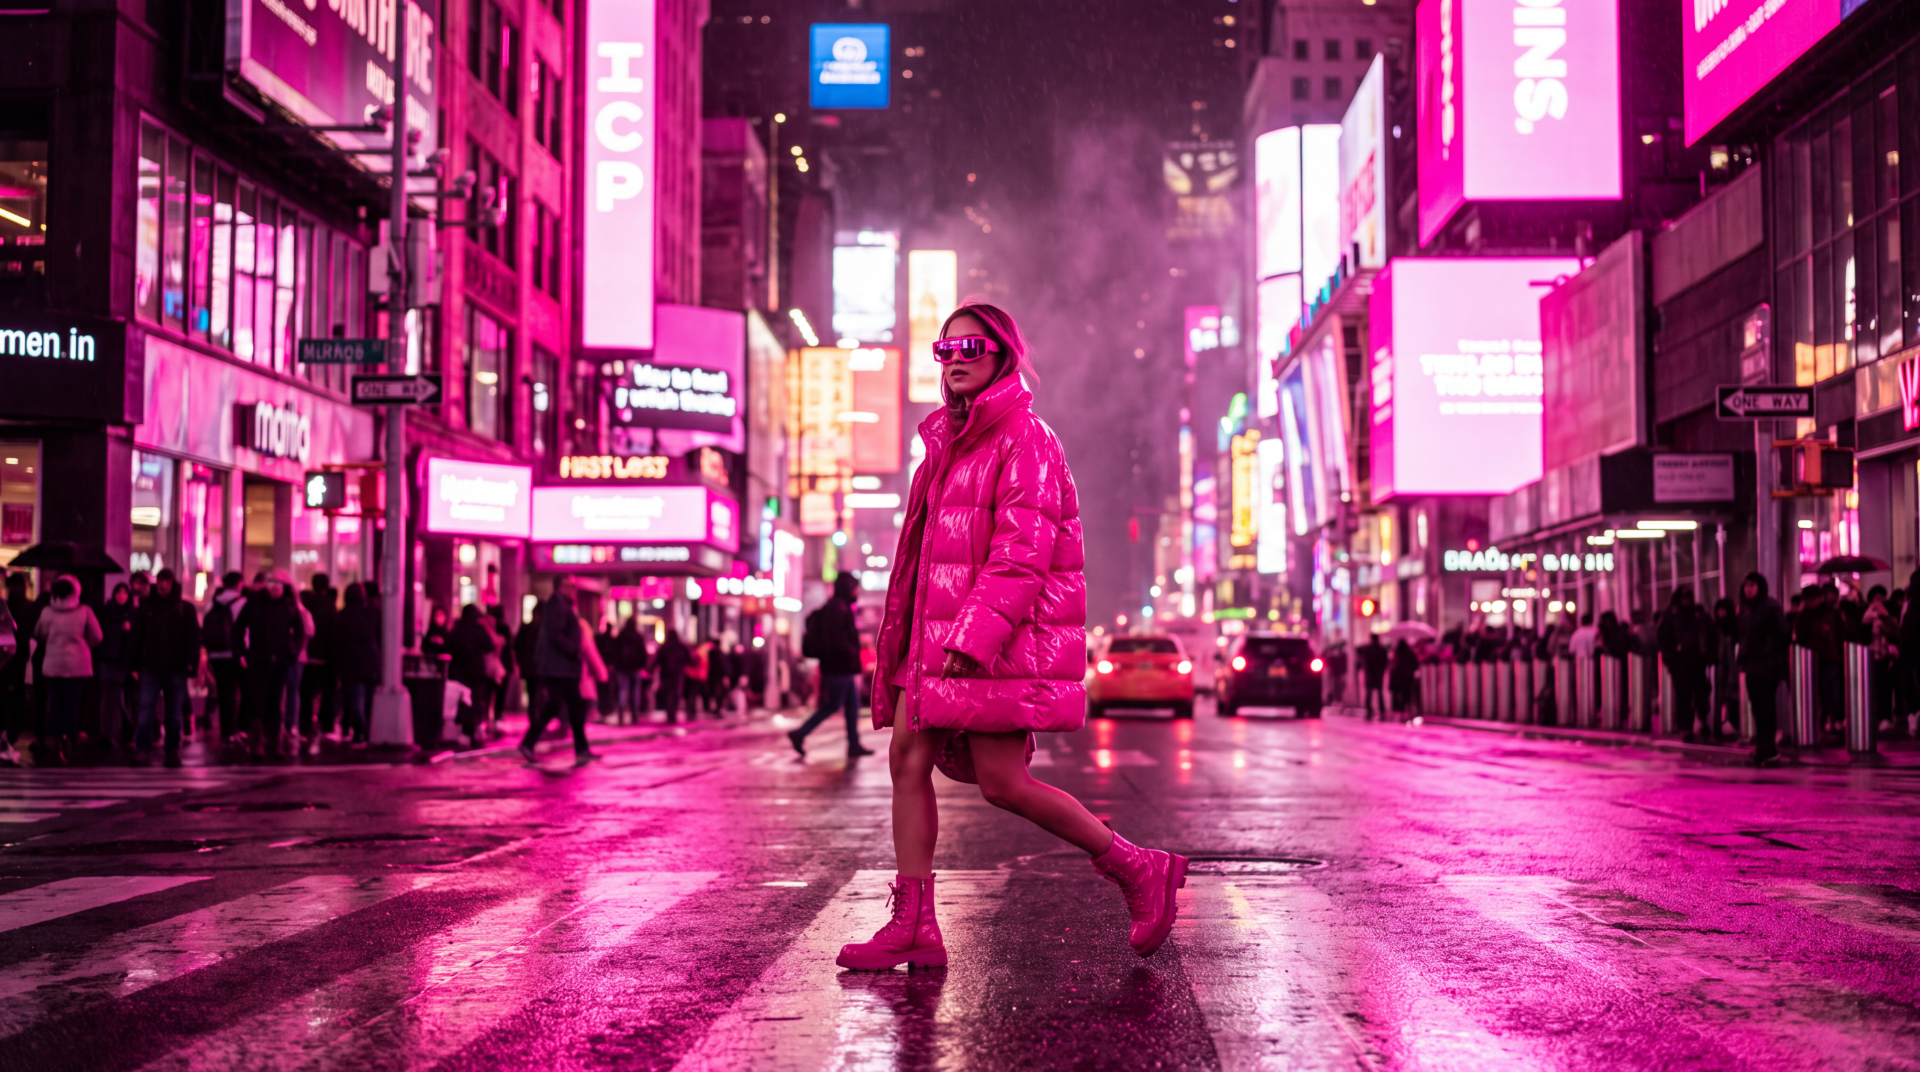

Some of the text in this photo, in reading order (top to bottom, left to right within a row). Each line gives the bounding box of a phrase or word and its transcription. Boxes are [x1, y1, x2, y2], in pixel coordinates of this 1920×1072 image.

[595, 42, 644, 212] ICP
[361, 382, 428, 395] ONE WAY
[1733, 394, 1804, 409] ONE WAY
